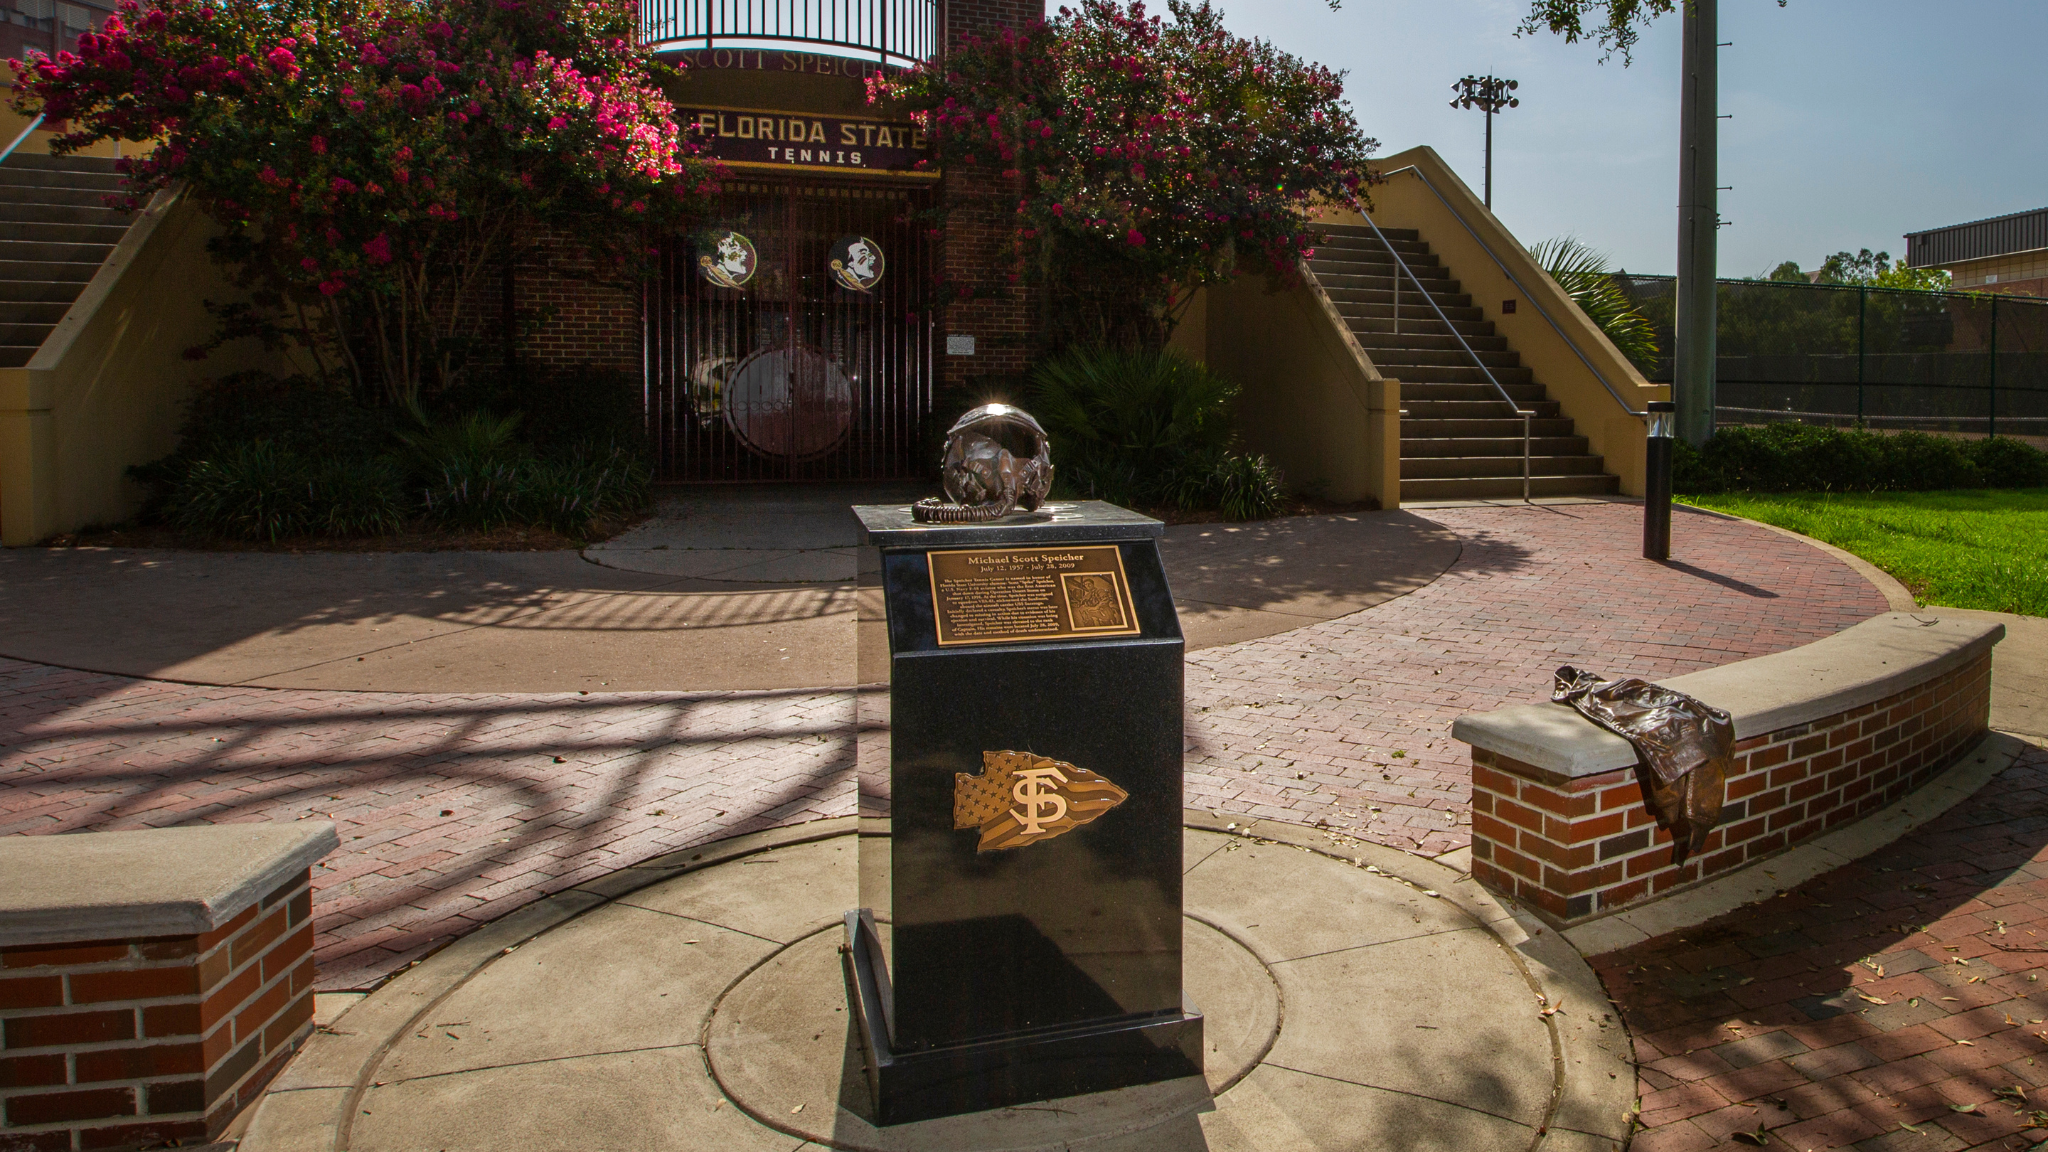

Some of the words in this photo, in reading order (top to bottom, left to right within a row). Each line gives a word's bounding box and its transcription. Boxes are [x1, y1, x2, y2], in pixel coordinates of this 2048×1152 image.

[682, 49, 769, 69] SCOTT
[782, 51, 898, 79] SPEICHE
[698, 112, 827, 144] FLORIDA
[840, 123, 928, 149] STATE
[768, 146, 862, 165] TENNIS
[968, 556, 1010, 564] Michael
[1012, 555, 1039, 563] Scott
[1041, 554, 1084, 563] Speicher
